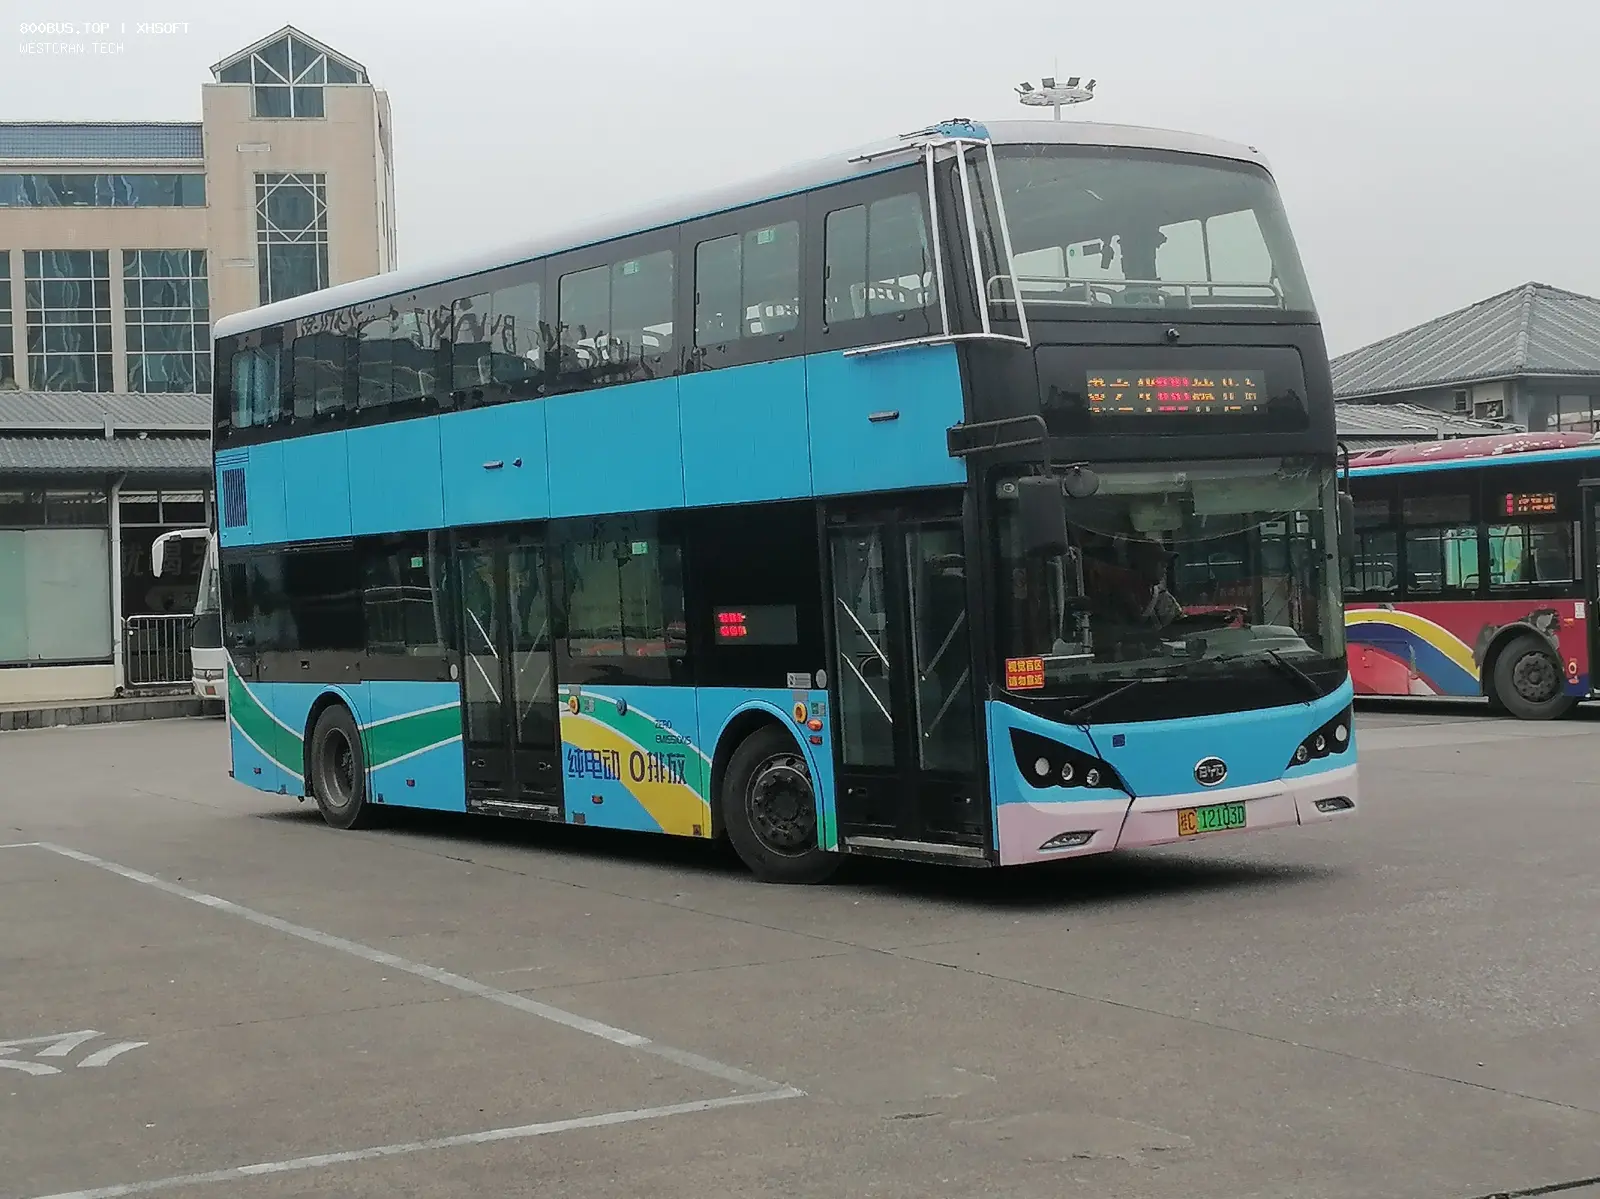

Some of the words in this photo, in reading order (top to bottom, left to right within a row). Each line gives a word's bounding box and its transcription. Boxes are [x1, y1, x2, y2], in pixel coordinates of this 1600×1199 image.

[1007, 659, 1042, 673] 视觉盲区
[654, 719, 673, 730] ZERO
[567, 748, 621, 781] 纯电动
